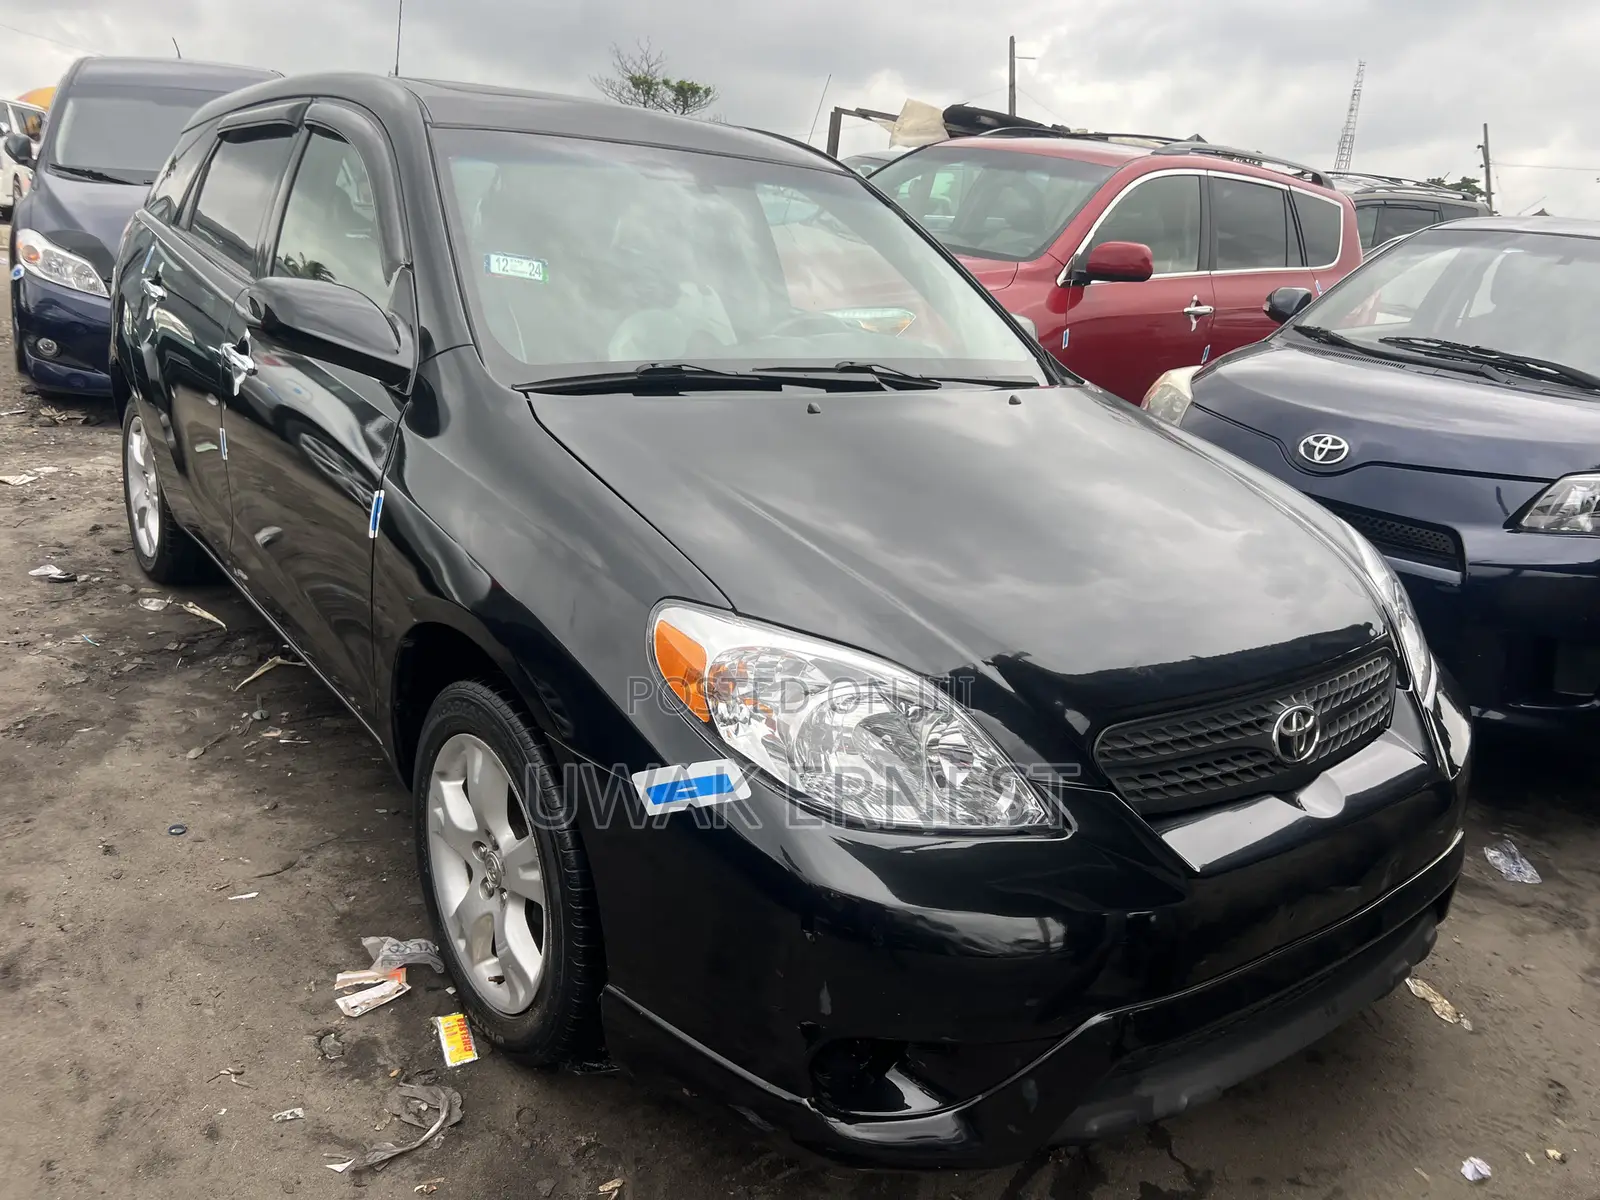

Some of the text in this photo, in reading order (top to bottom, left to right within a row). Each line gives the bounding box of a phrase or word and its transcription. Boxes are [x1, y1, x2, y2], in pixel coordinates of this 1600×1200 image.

[495, 257, 542, 278] 12 24
[456, 1017, 473, 1052] CHELSEA
